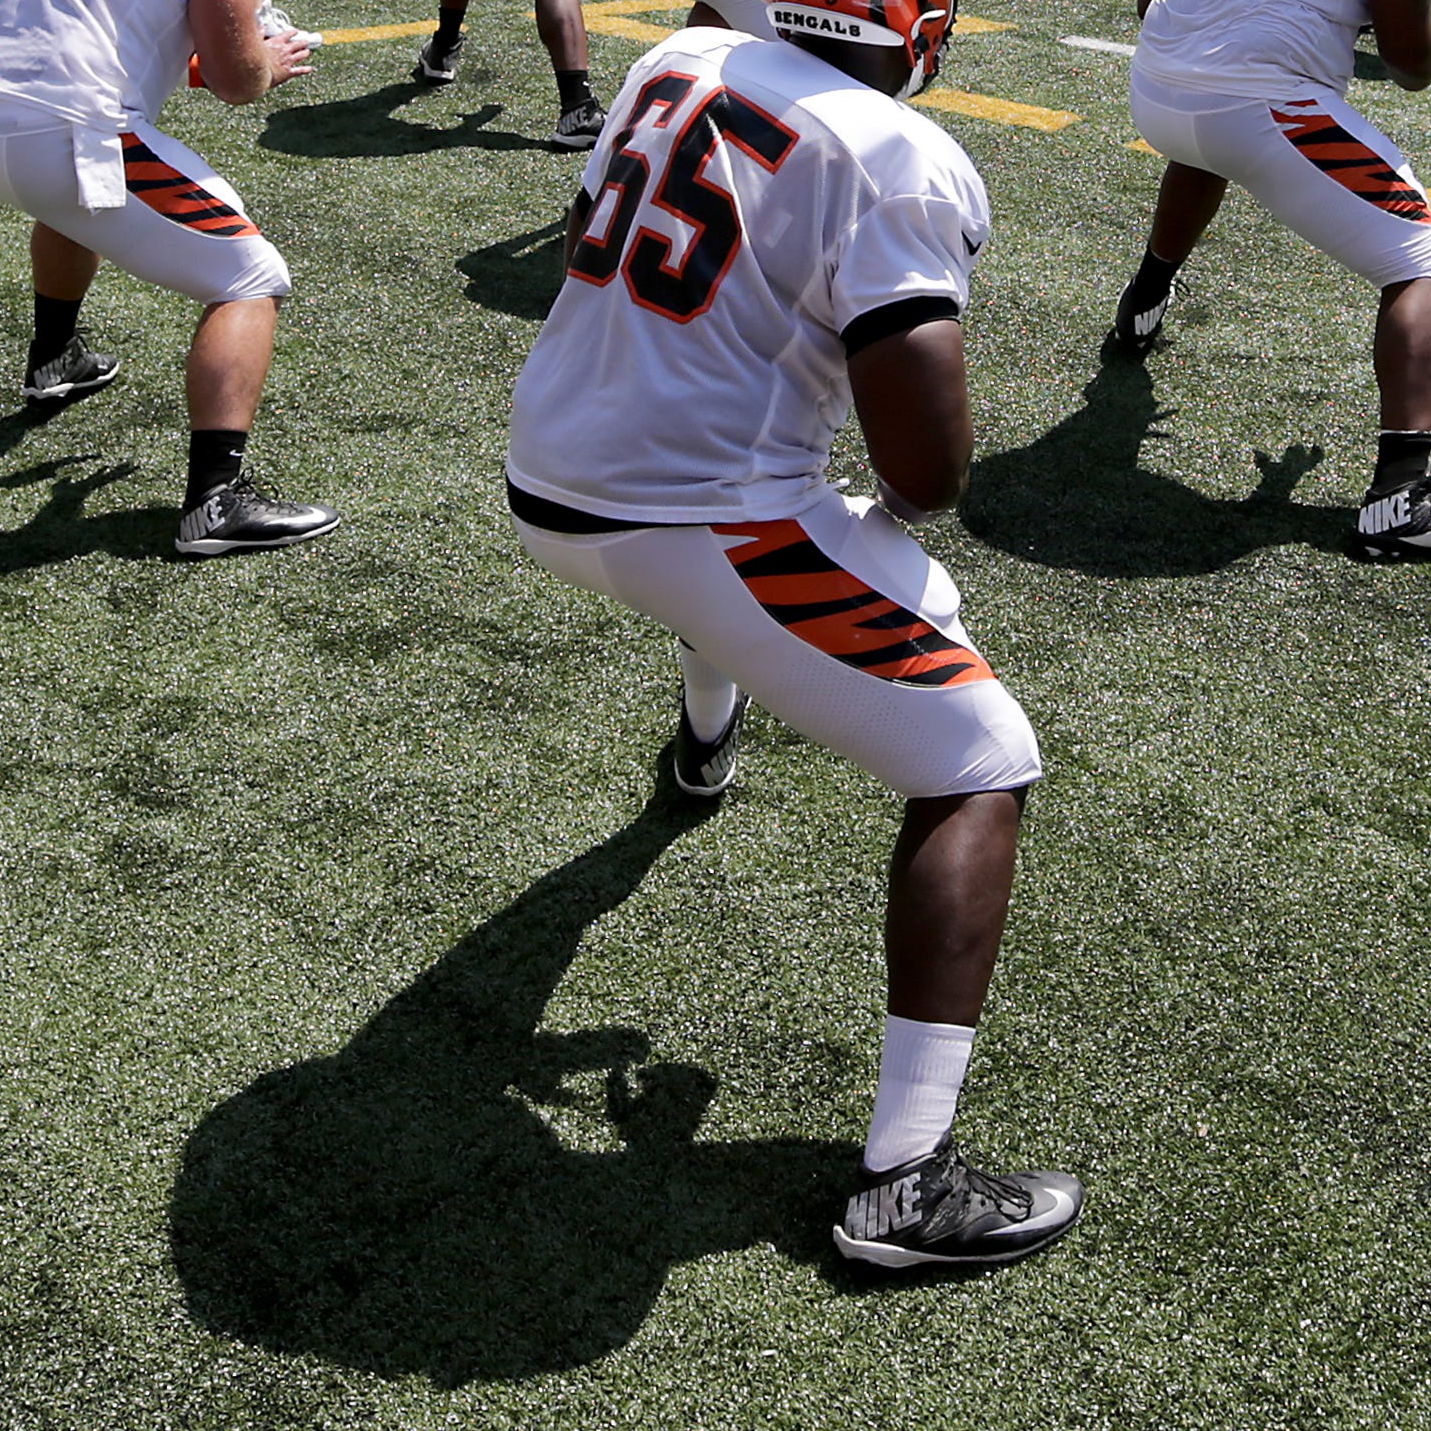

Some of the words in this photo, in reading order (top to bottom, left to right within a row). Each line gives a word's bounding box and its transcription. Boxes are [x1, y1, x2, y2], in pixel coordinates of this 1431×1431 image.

[774, 9, 862, 38] BENGALS
[567, 69, 801, 325] 65
[179, 495, 225, 542] NIKE
[1358, 490, 1412, 535] NIKE
[844, 1171, 923, 1241] NIKE
